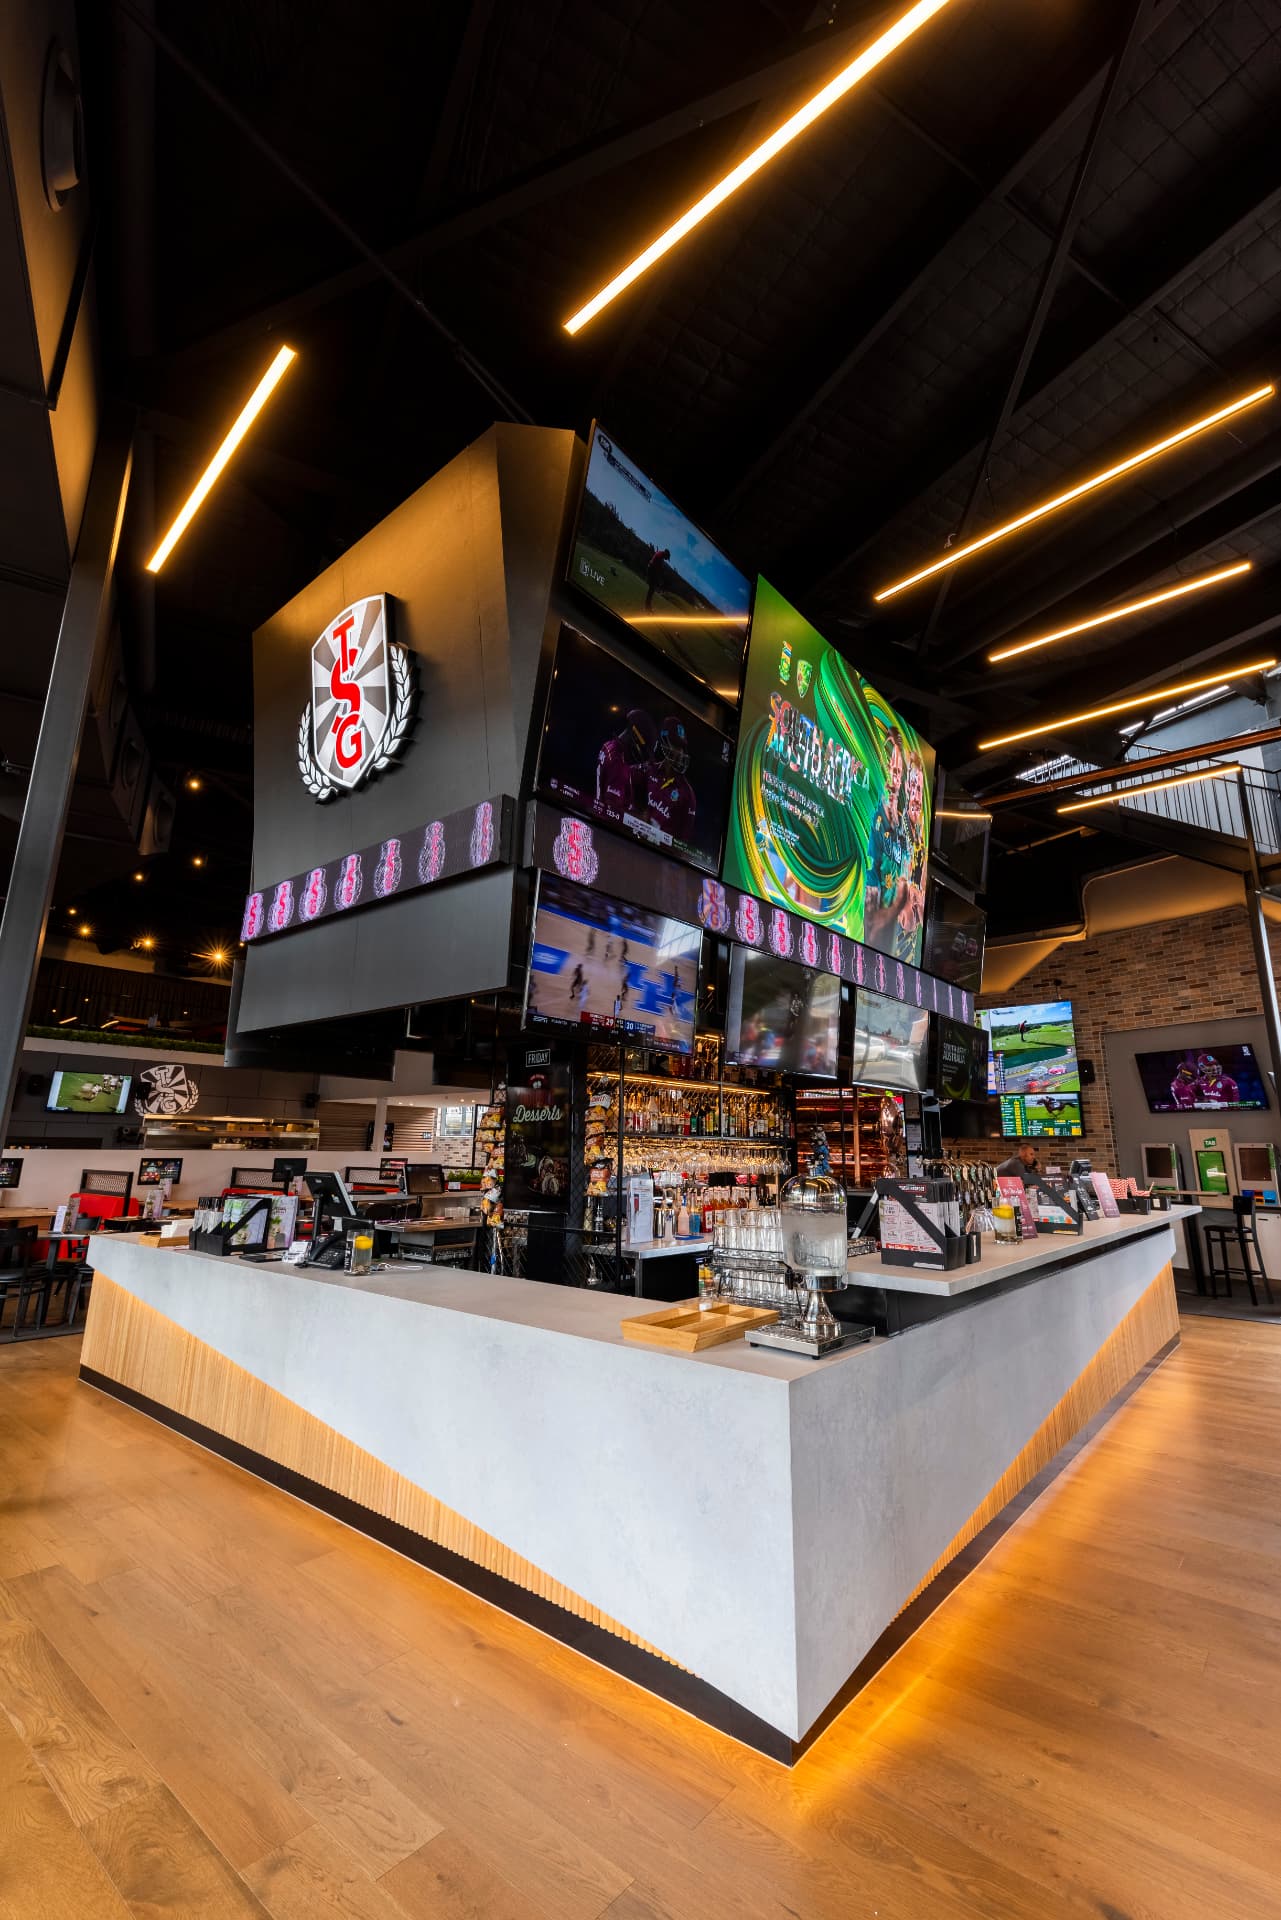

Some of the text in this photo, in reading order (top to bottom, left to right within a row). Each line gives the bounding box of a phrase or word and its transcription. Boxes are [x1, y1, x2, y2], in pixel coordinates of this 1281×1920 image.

[590, 568, 606, 586] LIVE
[331, 615, 363, 769] TSG
[528, 1052, 549, 1064] FRIDAY
[512, 1104, 562, 1123] Desserts
